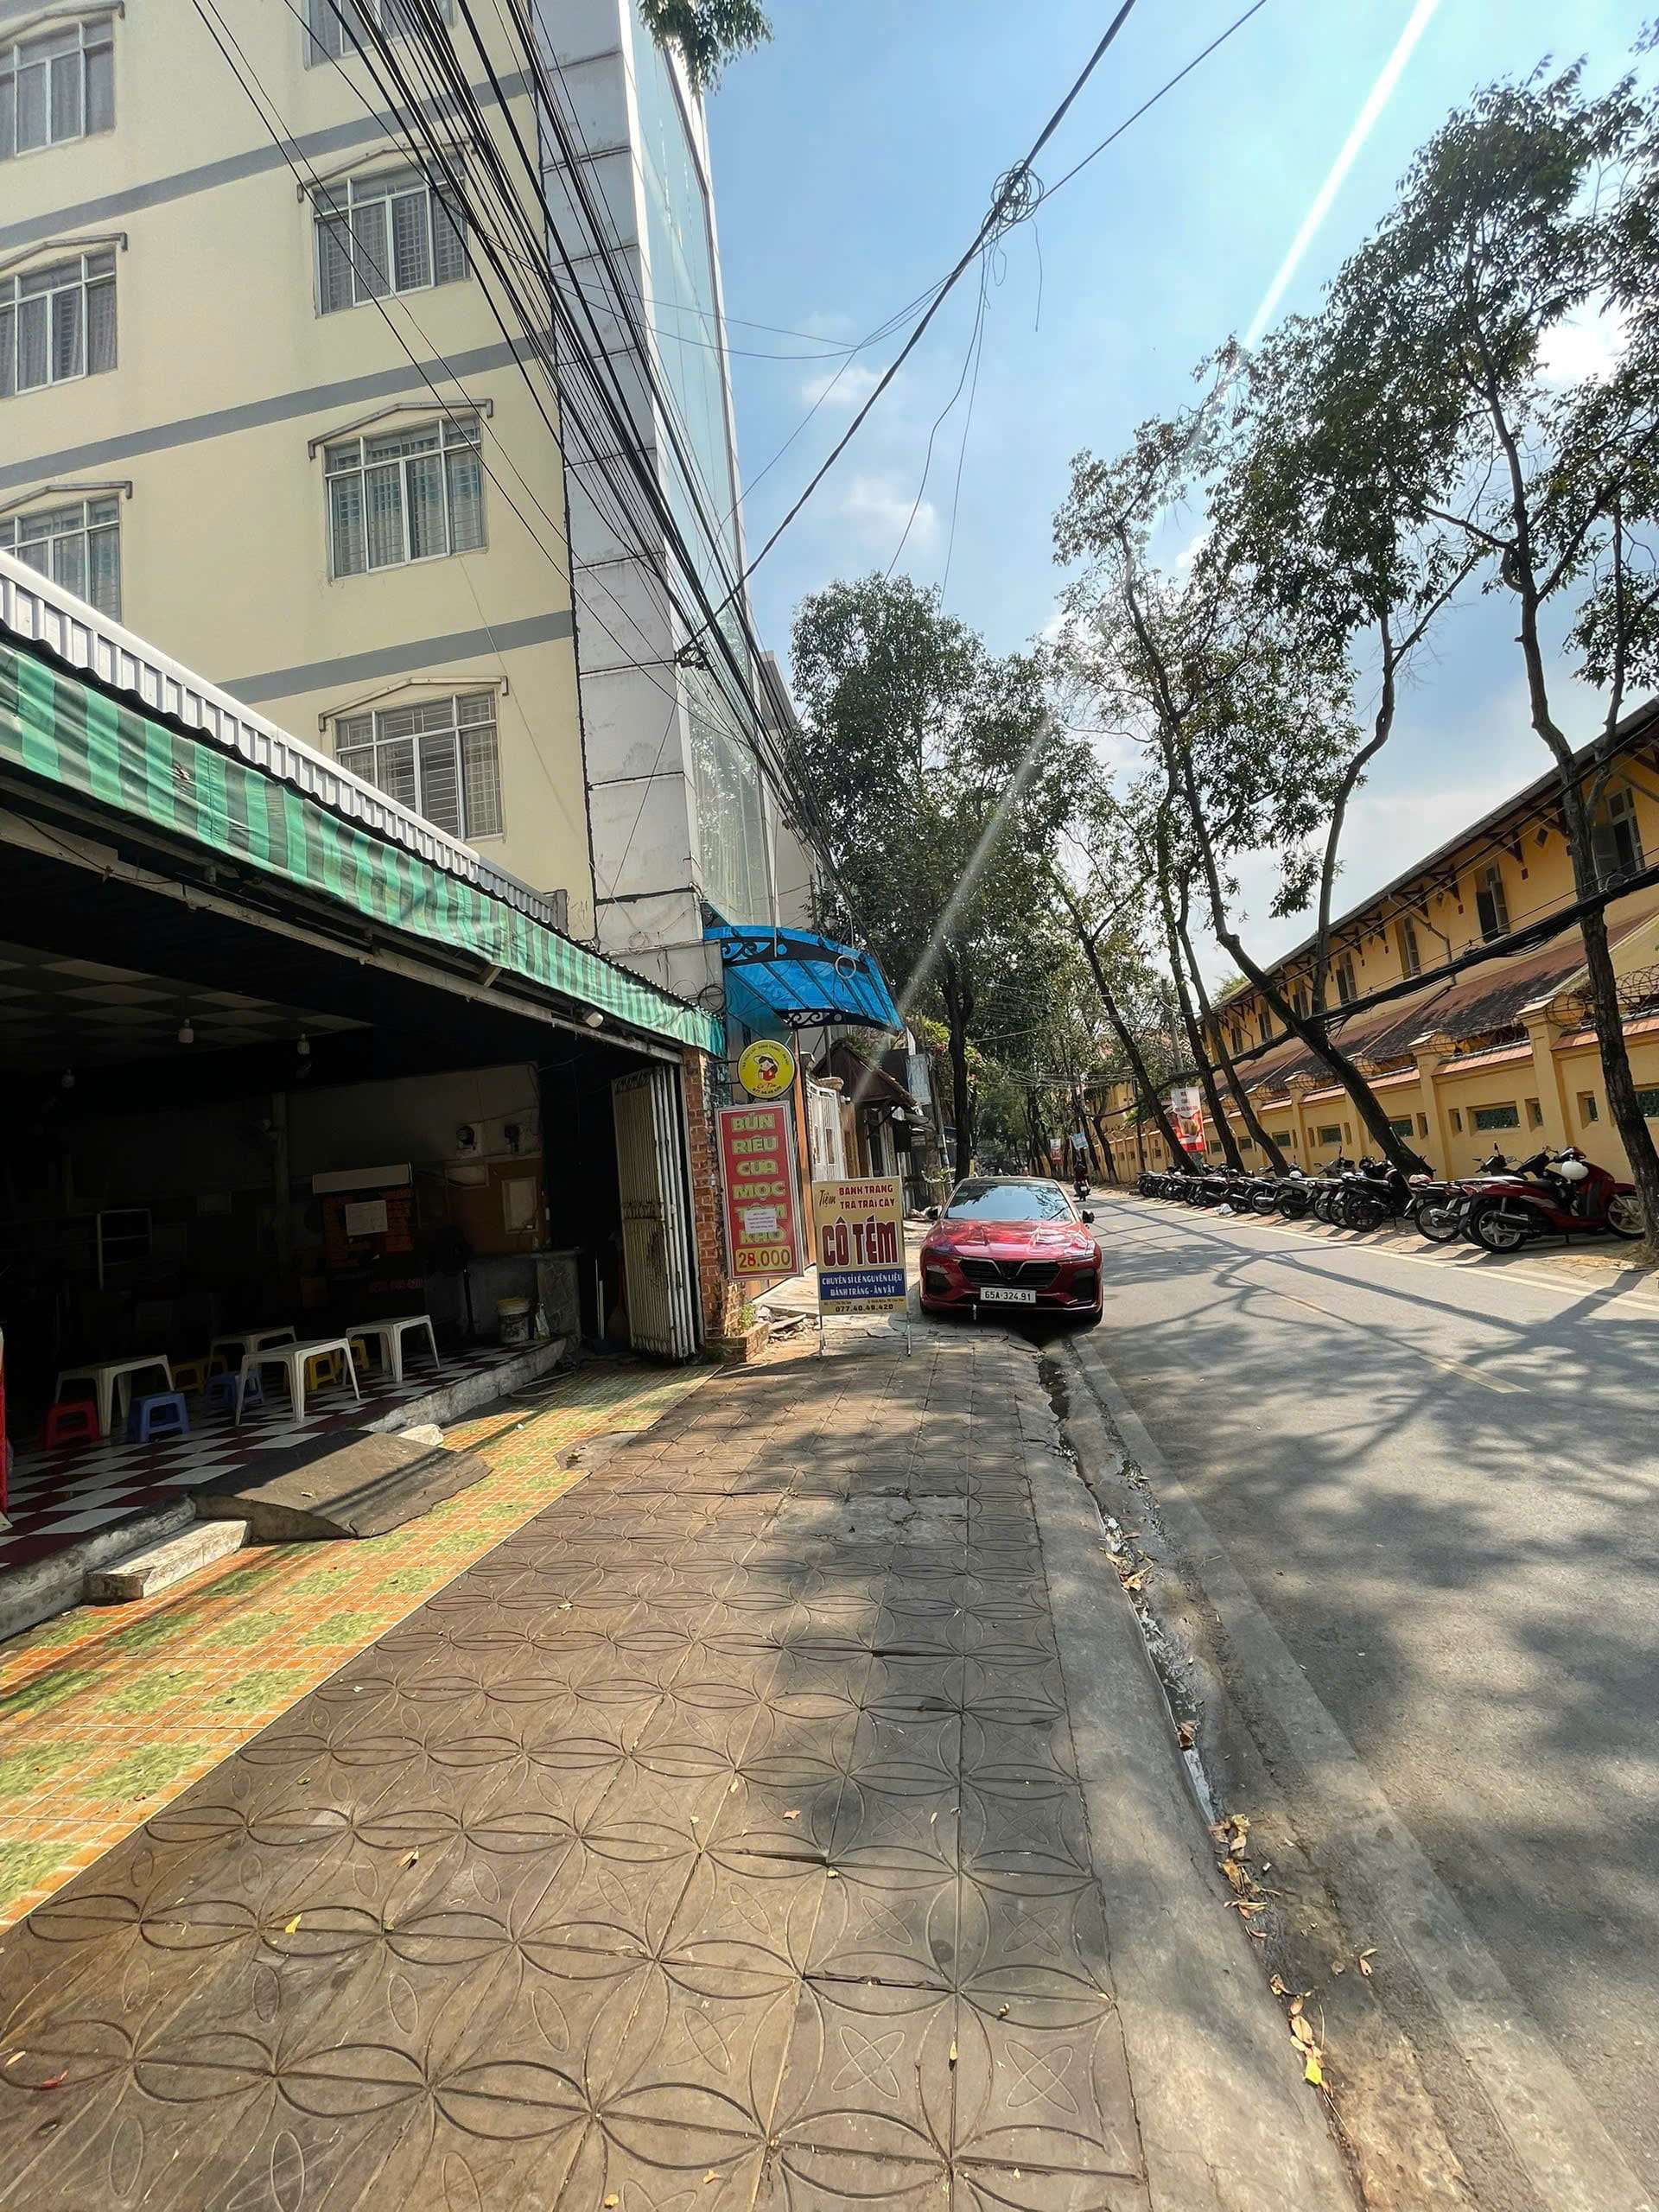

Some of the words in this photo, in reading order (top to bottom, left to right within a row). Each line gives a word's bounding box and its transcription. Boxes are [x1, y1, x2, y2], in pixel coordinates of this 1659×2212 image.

[732, 1135, 778, 1154] RIÊU
[736, 1159, 778, 1176] CUA
[732, 1181, 785, 1200] MỌC
[819, 1189, 836, 1207] Tiệm
[822, 1216, 850, 1268] CÔ
[852, 1214, 898, 1266] TÉM
[739, 1249, 790, 1268] 28.000
